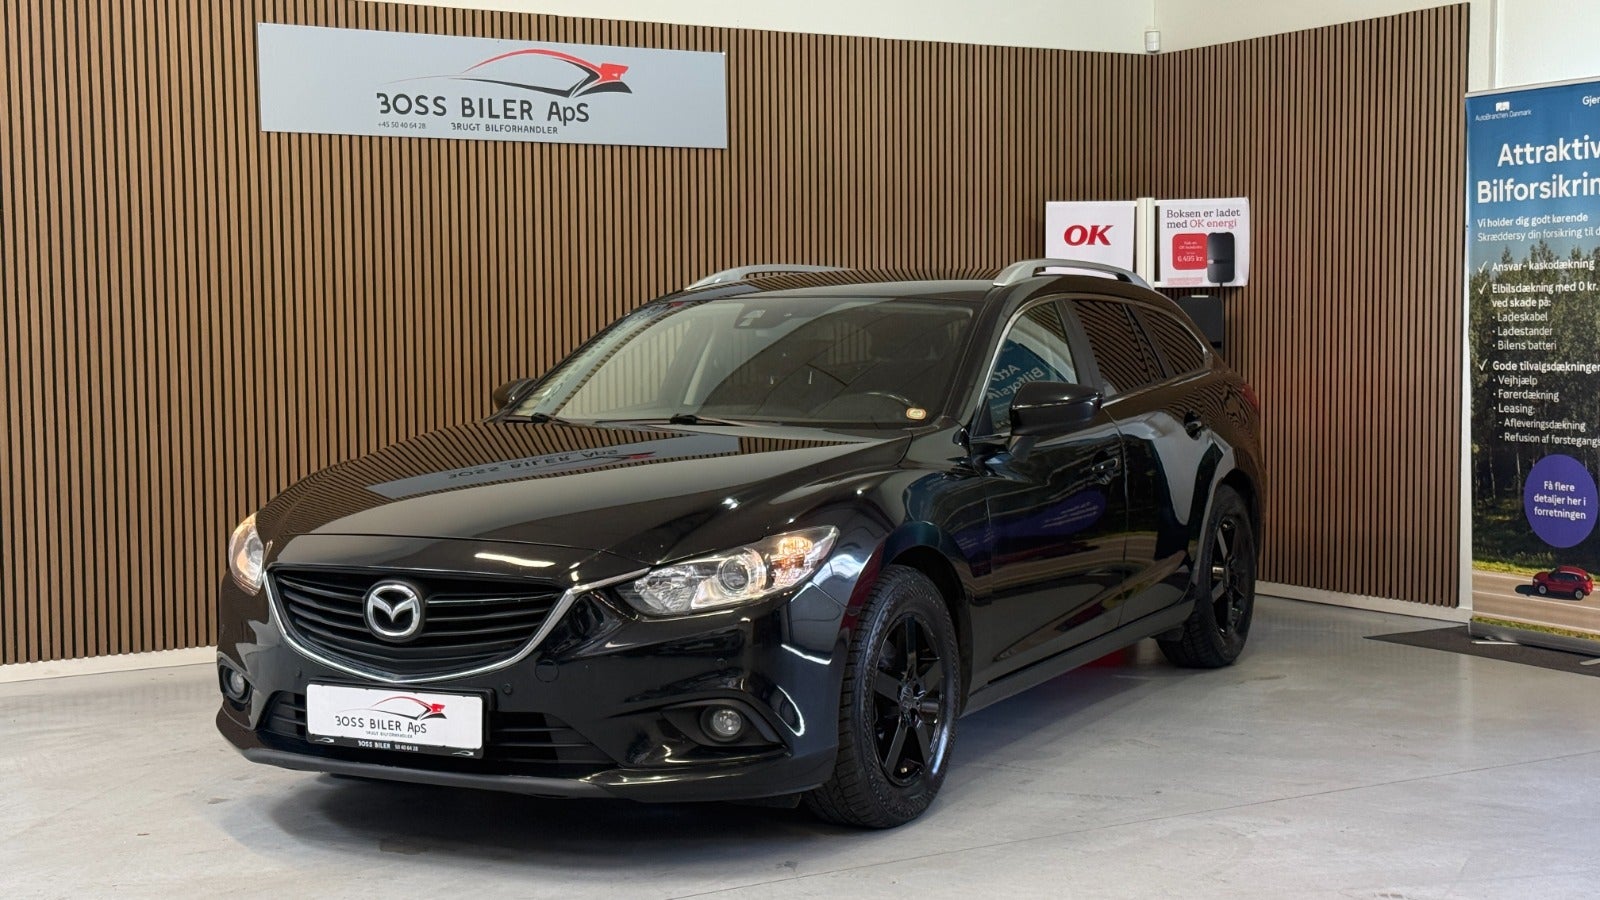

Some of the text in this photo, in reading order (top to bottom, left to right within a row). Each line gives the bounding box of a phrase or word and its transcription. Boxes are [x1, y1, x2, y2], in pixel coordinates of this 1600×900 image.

[376, 93, 590, 126] BOSS BILER ApS
[1475, 110, 1532, 122] AutoBranchen Danmark
[451, 122, 558, 134] BRUGT BILFORHANDLER
[1497, 134, 1600, 167] Attraktiv
[1477, 172, 1600, 204] Bilforsikrin
[1166, 208, 1240, 218] Boksen er ladet
[1167, 218, 1237, 229] med OK energi
[1477, 213, 1589, 228] Vi holder dig godt kørende
[1064, 224, 1113, 246] OK
[1477, 231, 1526, 242] Skræddersy
[1528, 230, 1542, 240] din
[1543, 228, 1582, 241] forsikring
[1584, 226, 1593, 236] til
[1492, 259, 1594, 272] Ansvar- kaskodækning
[1492, 281, 1598, 295] Elbilsdækning med 0 kr.
[1492, 298, 1508, 307] ved
[1510, 297, 1536, 307] skade
[1498, 312, 1548, 322] Ladeskabel
[1498, 326, 1553, 336] Ladestander
[1498, 341, 1557, 351] Bilens batteri
[1492, 361, 1517, 371] Gode
[1498, 376, 1538, 386] Vejhjælp
[1498, 389, 1559, 402] Førerdækning
[1504, 419, 1586, 432] Afleveringsdækning
[1504, 433, 1540, 443] Refusion
[1542, 434, 1550, 444] af
[1544, 480, 1575, 492] Få flere
[1534, 493, 1565, 505] detaljer
[1567, 496, 1581, 506] her
[1534, 507, 1586, 521] forretningen
[335, 716, 427, 735] BOSS BILER ApS
